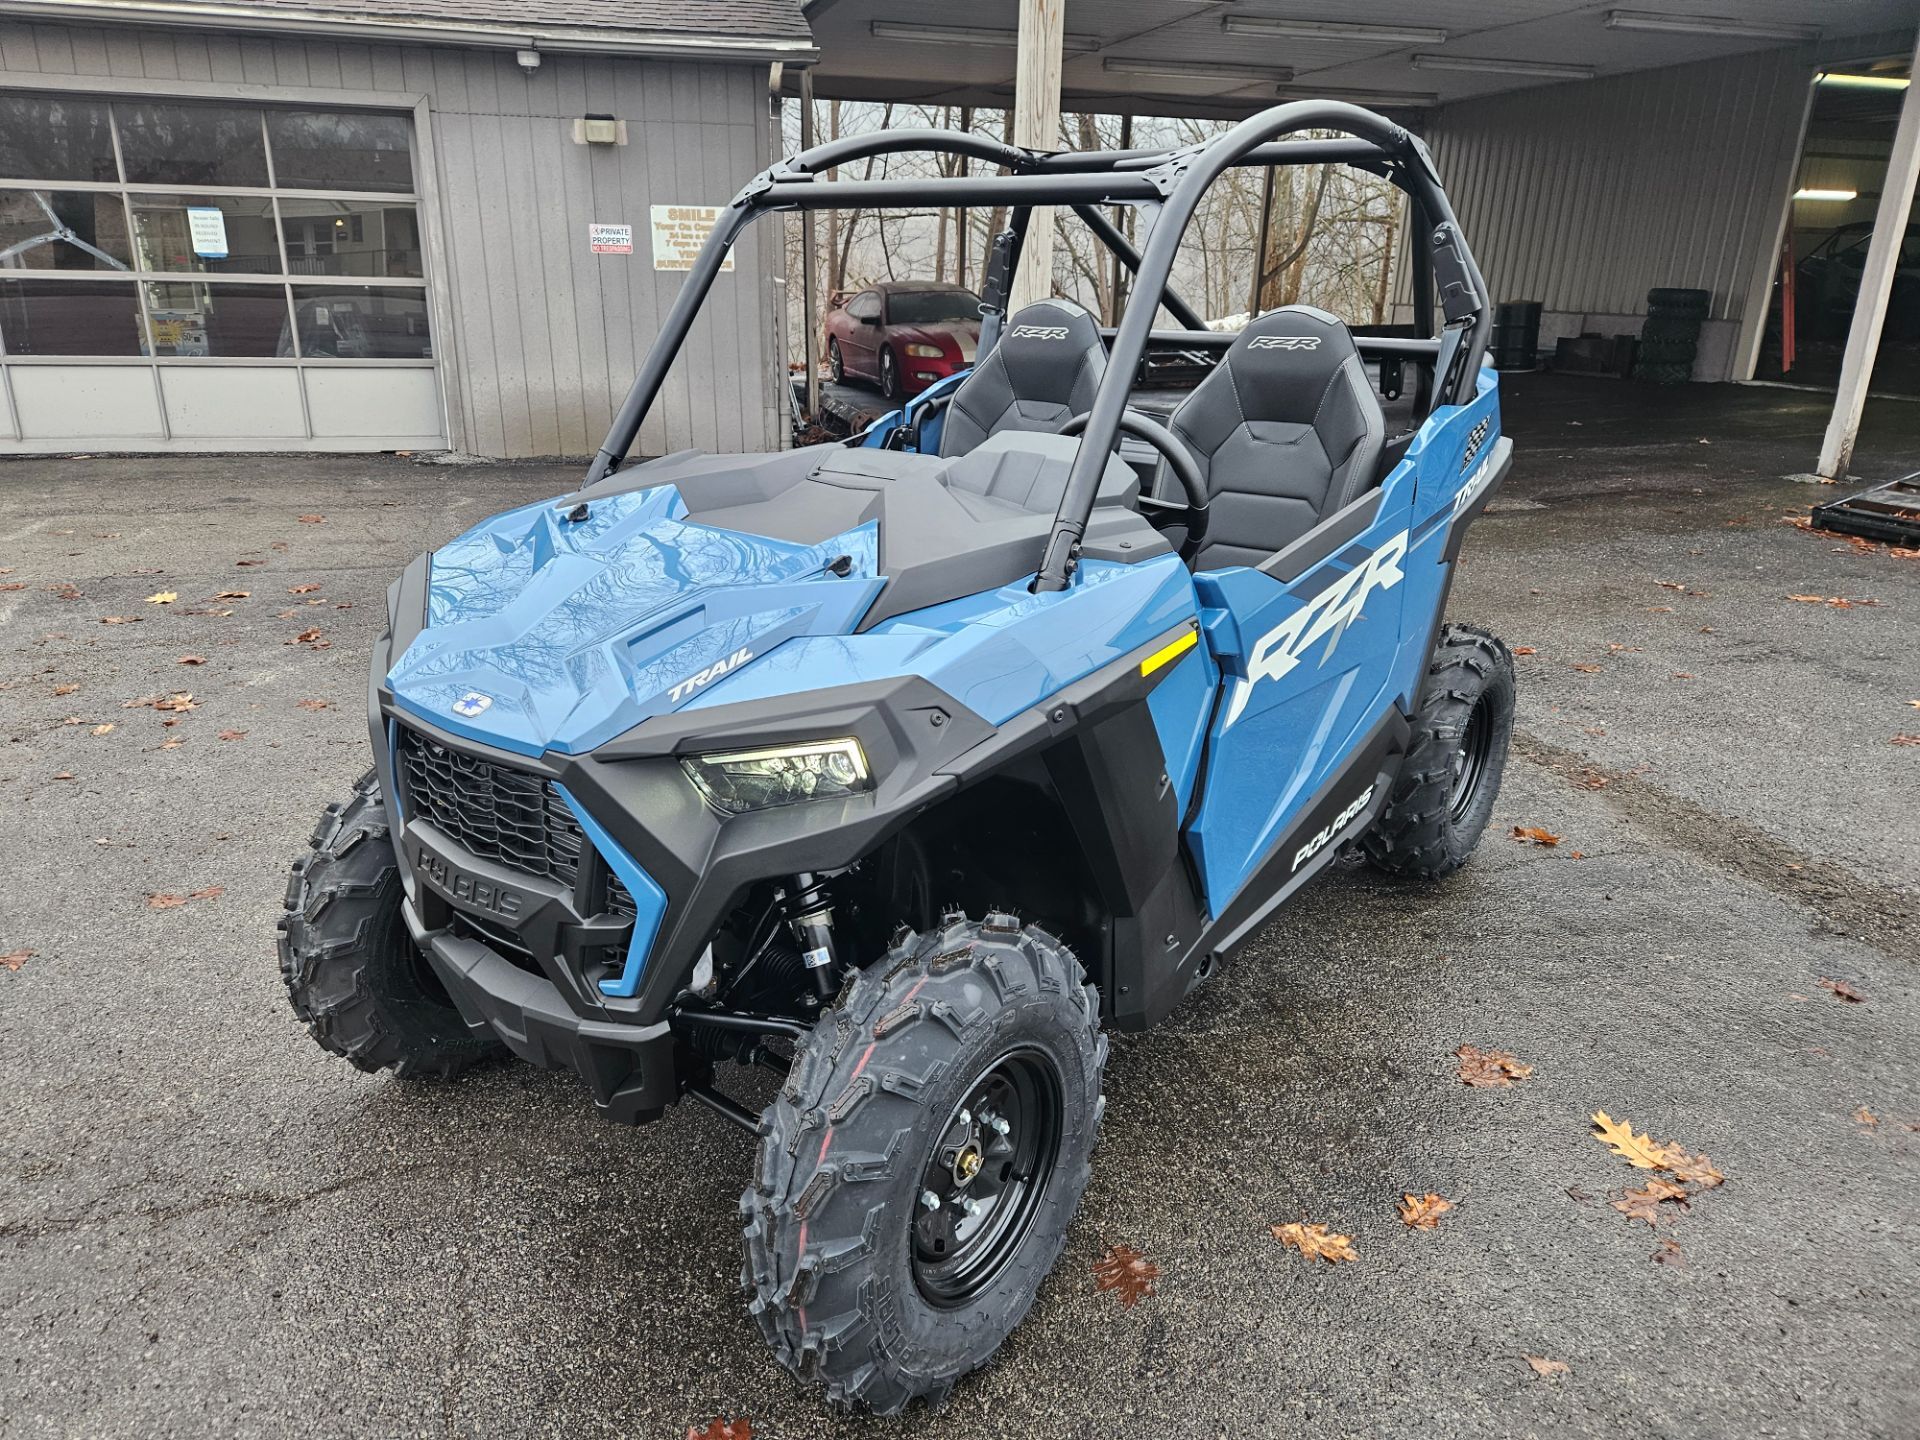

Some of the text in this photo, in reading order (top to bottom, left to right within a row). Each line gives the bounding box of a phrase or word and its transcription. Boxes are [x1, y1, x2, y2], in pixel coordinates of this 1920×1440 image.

[654, 222, 676, 230] Your
[668, 208, 716, 221] SMILE
[1012, 325, 1069, 340] RZR
[1248, 336, 1321, 350] RZR
[1454, 455, 1489, 512] TRAIL
[1226, 529, 1409, 728] RZR
[667, 648, 753, 703] TRAIL
[1291, 784, 1374, 872] POLARIS
[417, 847, 522, 920] POLARIS
